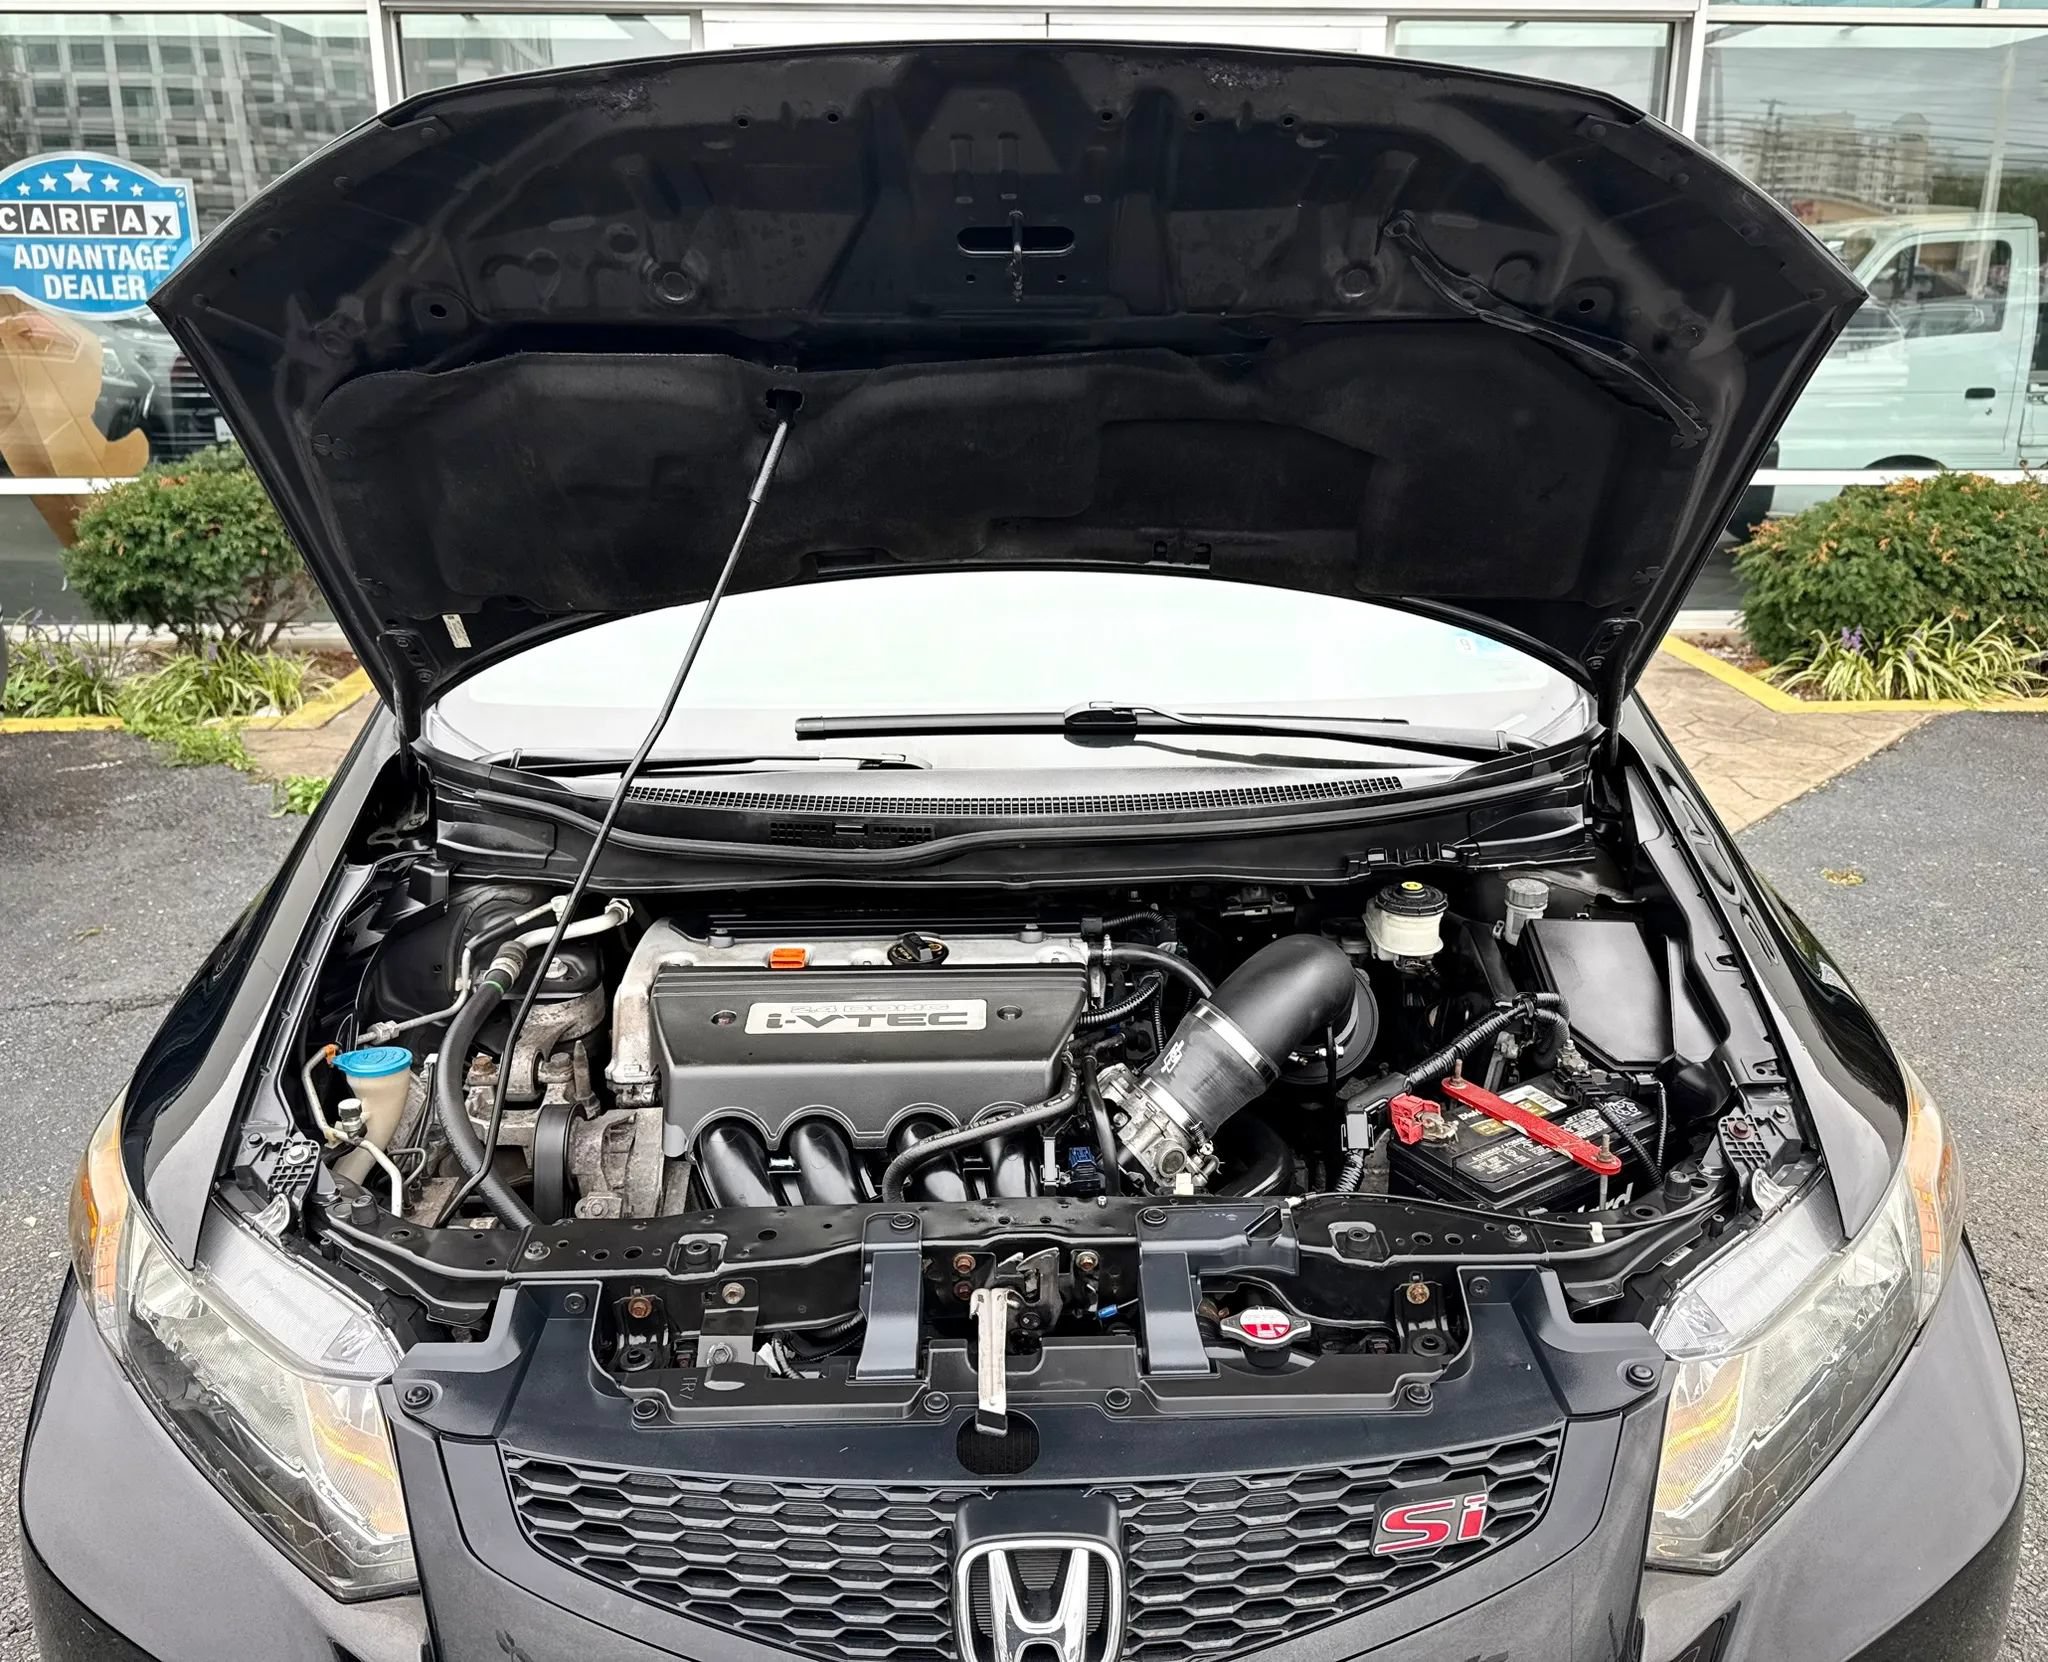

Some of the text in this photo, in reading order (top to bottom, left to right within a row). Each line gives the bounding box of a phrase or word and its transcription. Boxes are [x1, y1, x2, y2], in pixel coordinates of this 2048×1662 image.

[0, 206, 174, 236] CARFAX
[13, 243, 171, 271] ADVANTAGE
[43, 274, 148, 301] DEALER
[766, 1011, 968, 1029] i-VTEC
[1374, 1493, 1488, 1555] Si
